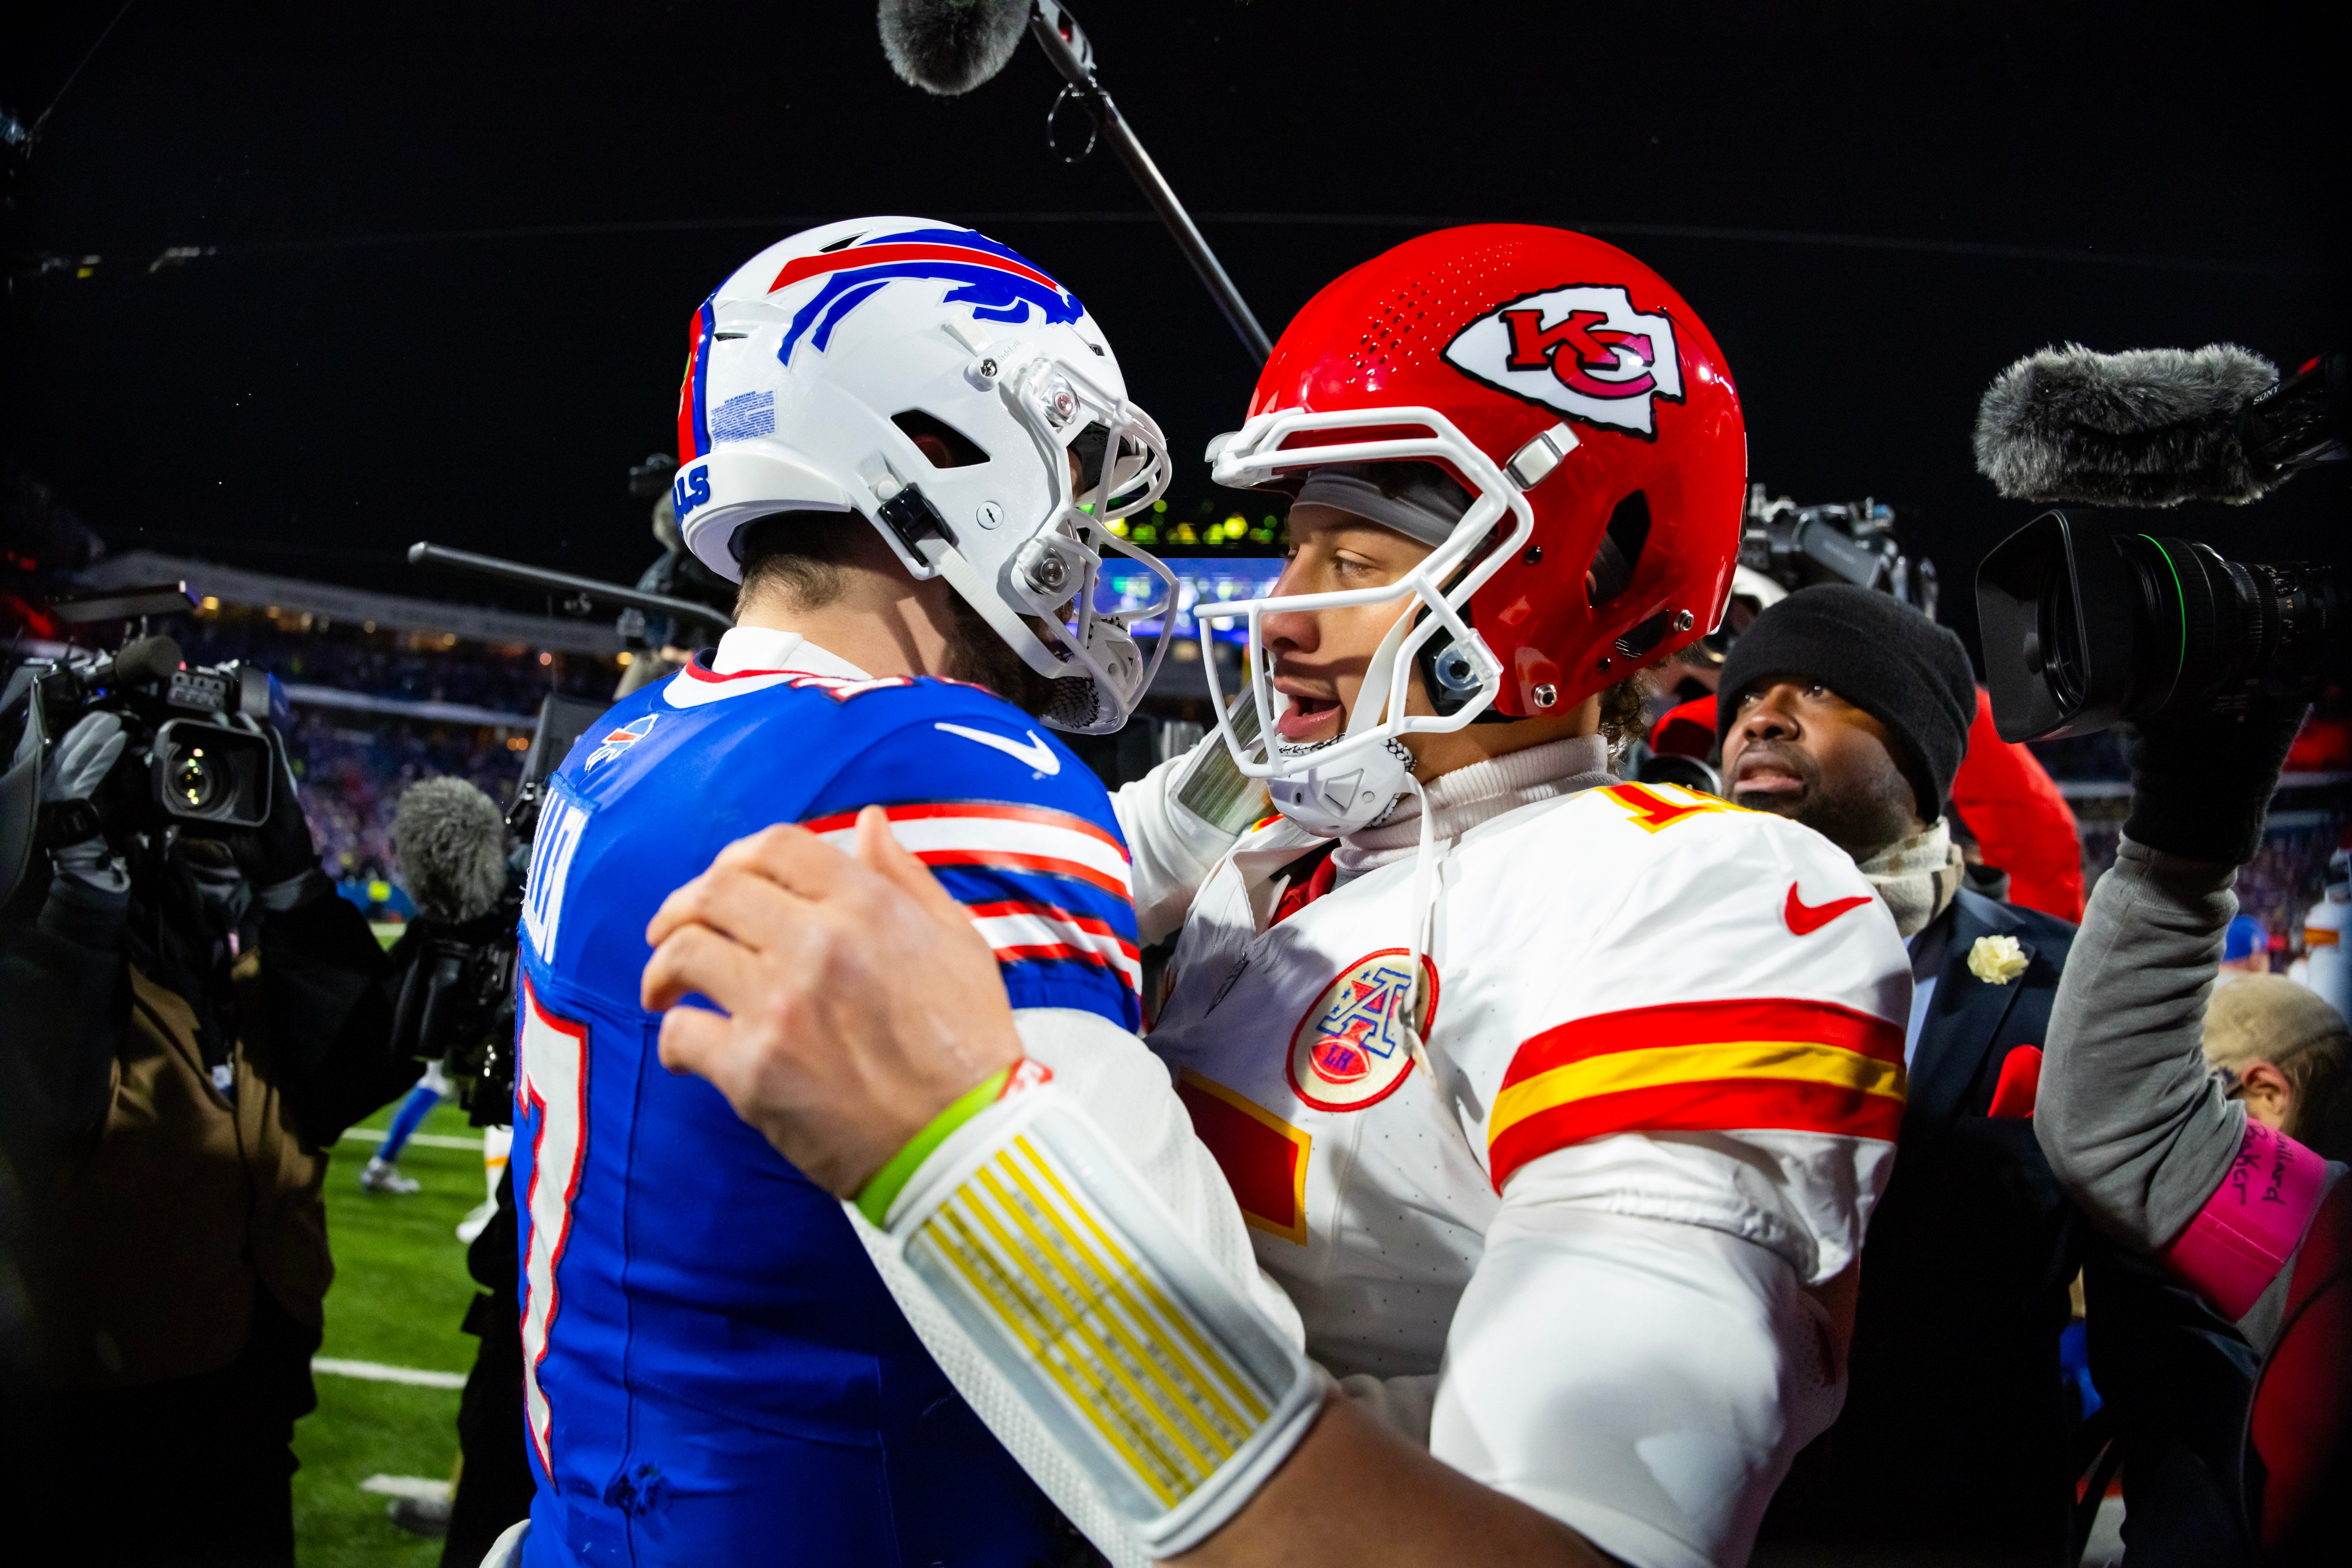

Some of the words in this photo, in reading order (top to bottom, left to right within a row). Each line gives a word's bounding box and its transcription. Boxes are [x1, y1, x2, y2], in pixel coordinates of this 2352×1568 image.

[1499, 309, 1657, 400] KC
[724, 391, 756, 404] WARNING
[2253, 383, 2281, 405] SONY
[1324, 1044, 1354, 1071] LH
